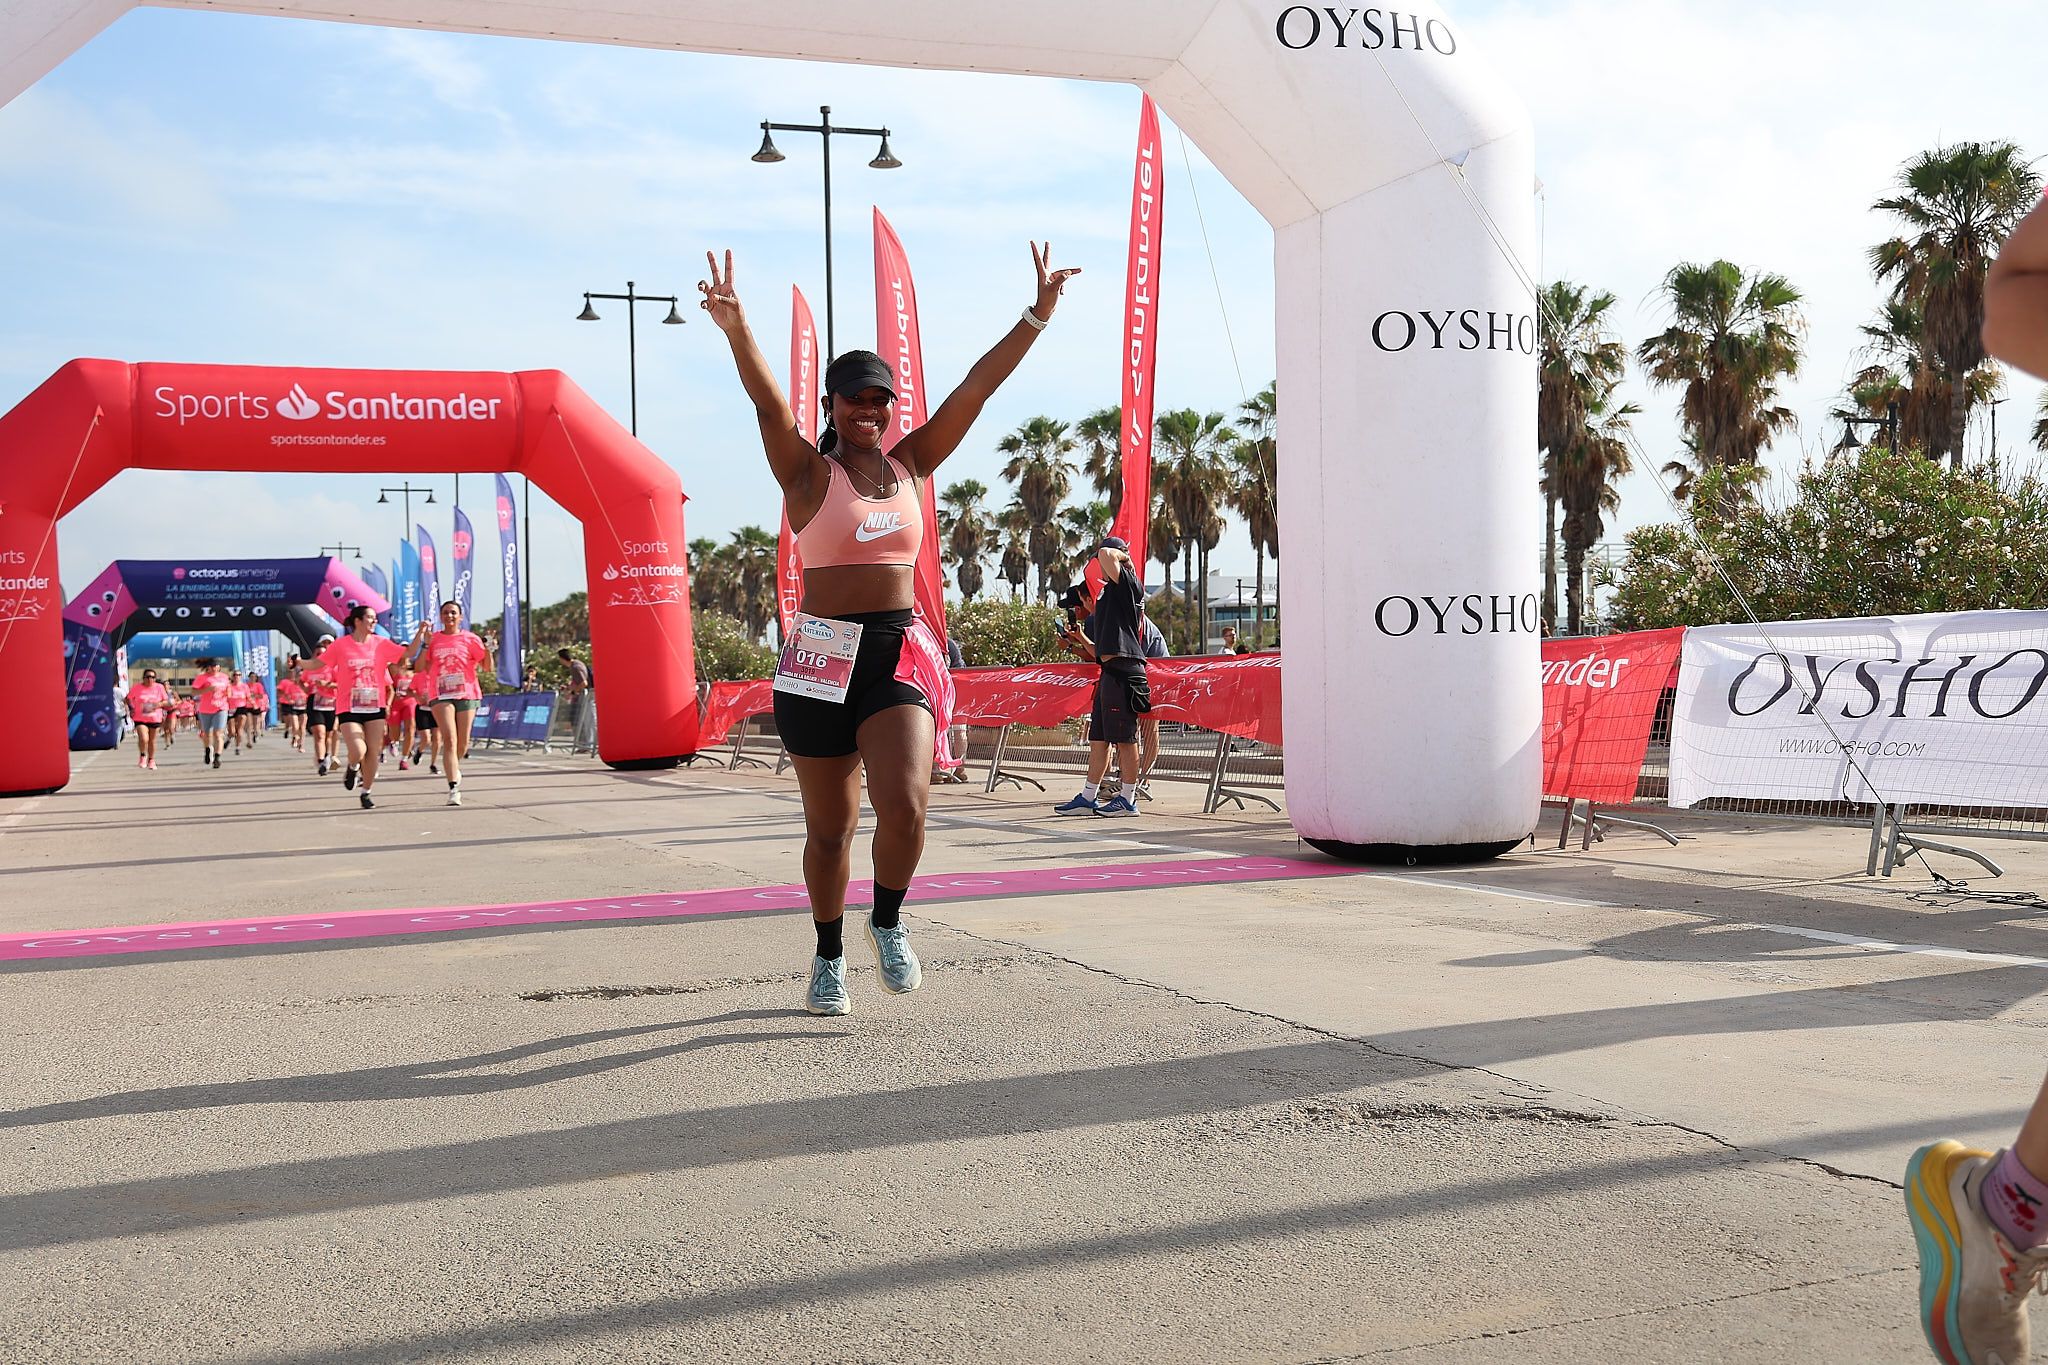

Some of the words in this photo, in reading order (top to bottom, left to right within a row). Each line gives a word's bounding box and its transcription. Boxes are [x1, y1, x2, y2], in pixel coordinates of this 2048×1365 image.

[1276, 5, 1457, 56] OYSHO
[1371, 309, 1535, 355] OYSHO
[154, 386, 270, 426] Sports
[326, 390, 502, 421] Santander
[270, 433, 387, 447] sportssantander.es
[865, 511, 901, 529] NIKE
[0, 550, 26, 564] rts
[622, 540, 669, 557] Sports
[148, 605, 267, 618] VOLVO
[1374, 593, 1538, 637] OYSHO
[796, 650, 828, 668] 016
[1728, 648, 2048, 719] OYSHO
[1778, 738, 1926, 757] WWW.OYSHO.COM
